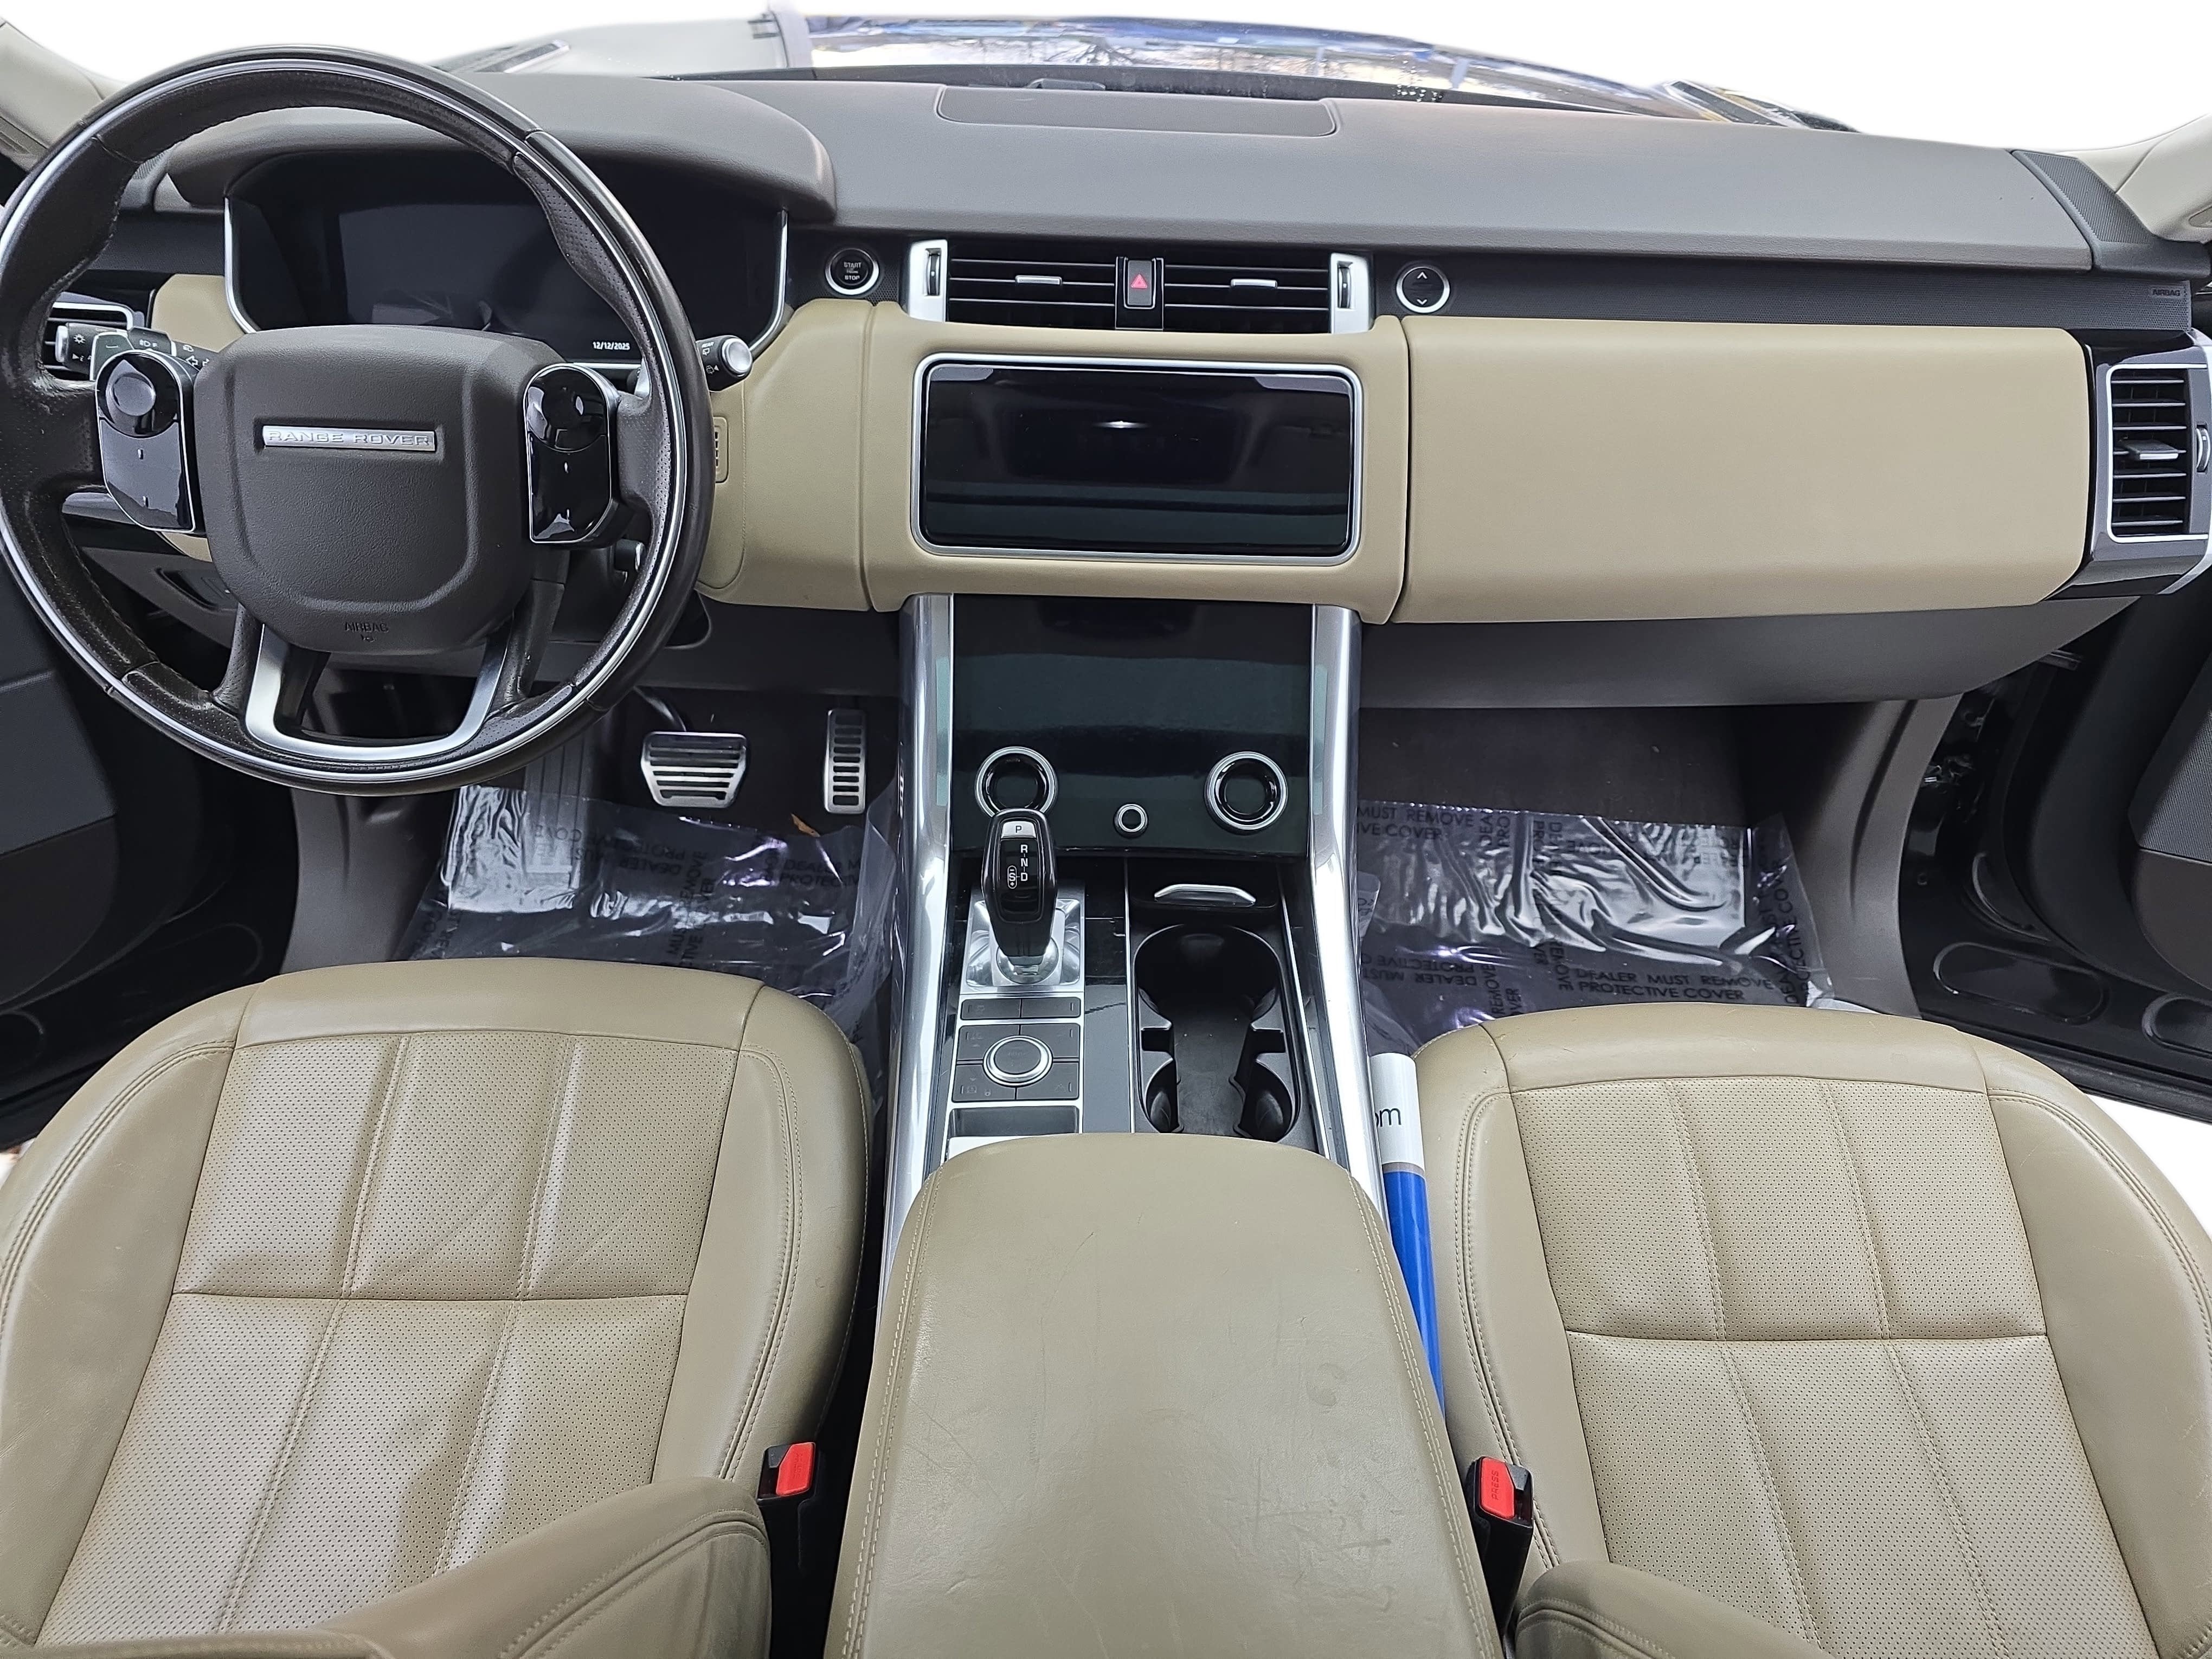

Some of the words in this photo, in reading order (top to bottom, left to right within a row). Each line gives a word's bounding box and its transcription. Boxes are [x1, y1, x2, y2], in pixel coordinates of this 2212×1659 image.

[2152, 288, 2181, 297] AIRBAG
[593, 341, 631, 350] 12/12/2025
[268, 430, 344, 443] RANGE
[353, 433, 429, 446] ROVER
[344, 621, 389, 633] AIRBAG
[1406, 808, 1474, 827] REMOVE
[1015, 825, 1022, 833] P
[1386, 824, 1443, 840] COVER
[1020, 844, 1028, 853] R
[1020, 858, 1028, 867] N
[1009, 872, 1016, 882] S
[1020, 872, 1028, 882] D
[1377, 955, 1474, 973] PROTECTIVE
[1362, 968, 1404, 982] MUST
[1415, 973, 1477, 986] DEALER
[1574, 967, 1637, 982] DEALER
[1648, 973, 1690, 985] MUST
[1700, 975, 1775, 991] REMOVE
[1480, 965, 1506, 1015] REMOVE
[1578, 981, 1679, 998] PROTECTIVE
[1683, 987, 1744, 1000] COVER
[1490, 1469, 1500, 1500] PRESS
